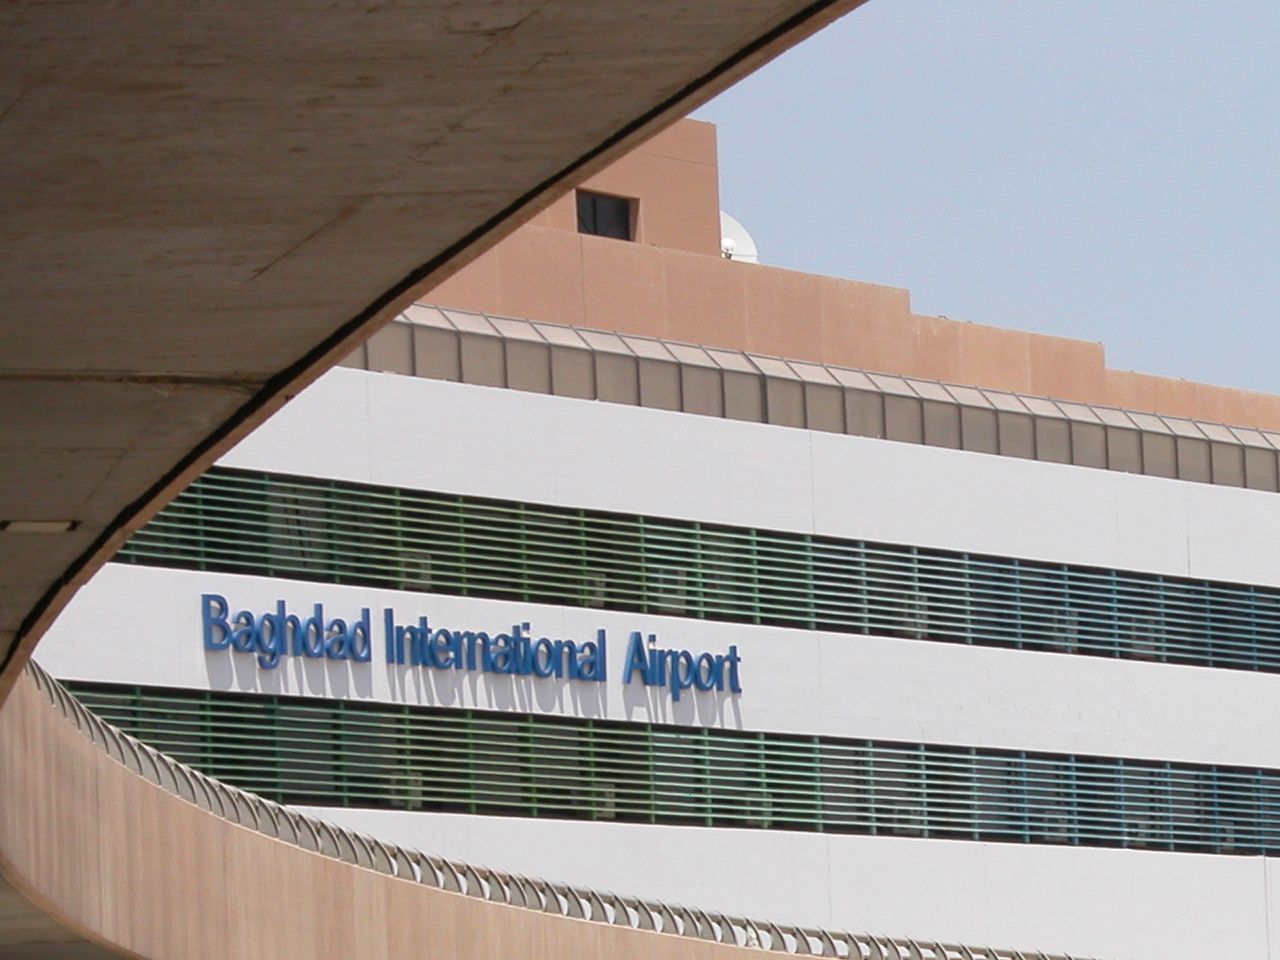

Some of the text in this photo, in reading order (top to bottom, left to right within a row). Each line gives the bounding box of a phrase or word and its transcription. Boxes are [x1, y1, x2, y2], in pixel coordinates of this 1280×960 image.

[201, 593, 742, 701] Baghdad International Airport
